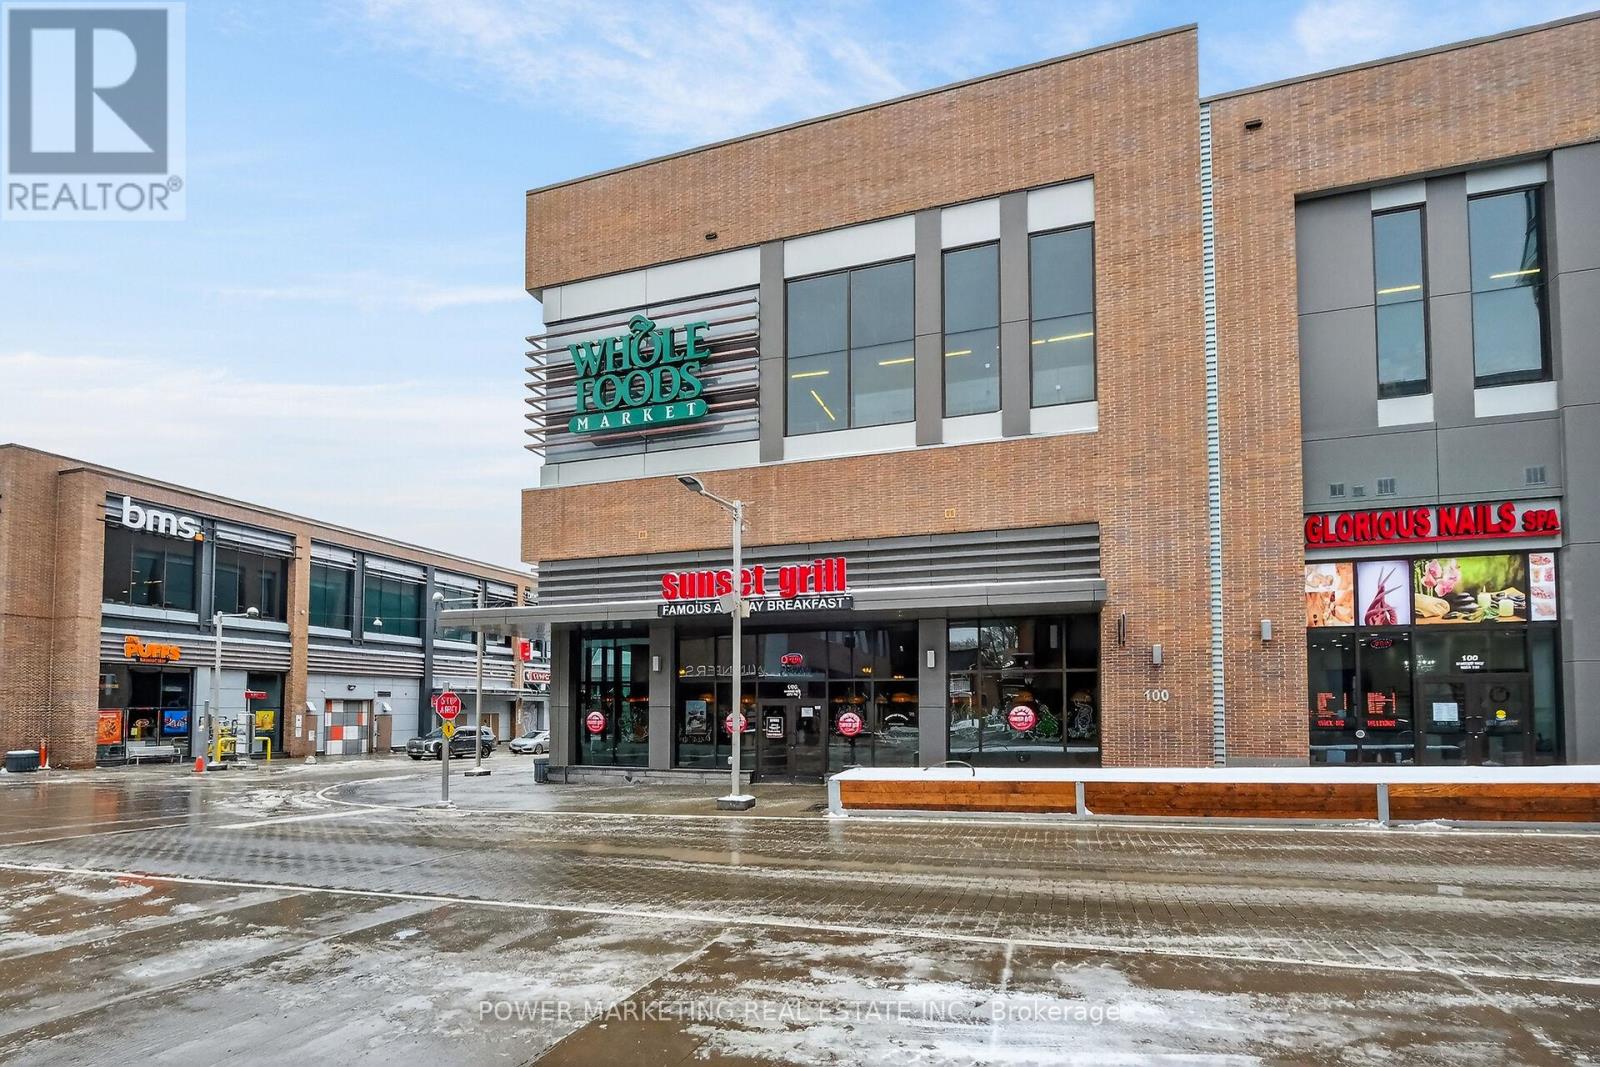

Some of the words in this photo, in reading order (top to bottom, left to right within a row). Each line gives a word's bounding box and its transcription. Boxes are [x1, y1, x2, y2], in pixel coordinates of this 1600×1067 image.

[567, 314, 711, 377] WHOLE
[575, 361, 703, 413] FOODS
[577, 402, 697, 430] MARKET
[1304, 507, 1431, 544] GLORIOUS
[1437, 501, 1516, 537] NAILS
[1522, 508, 1560, 531] SPA
[661, 564, 766, 602] sunset
[778, 556, 847, 599] grill
[662, 604, 711, 616] FAMOUS
[749, 600, 765, 612] AY
[767, 598, 844, 612] BREAKFAST
[1143, 689, 1169, 701] 100
